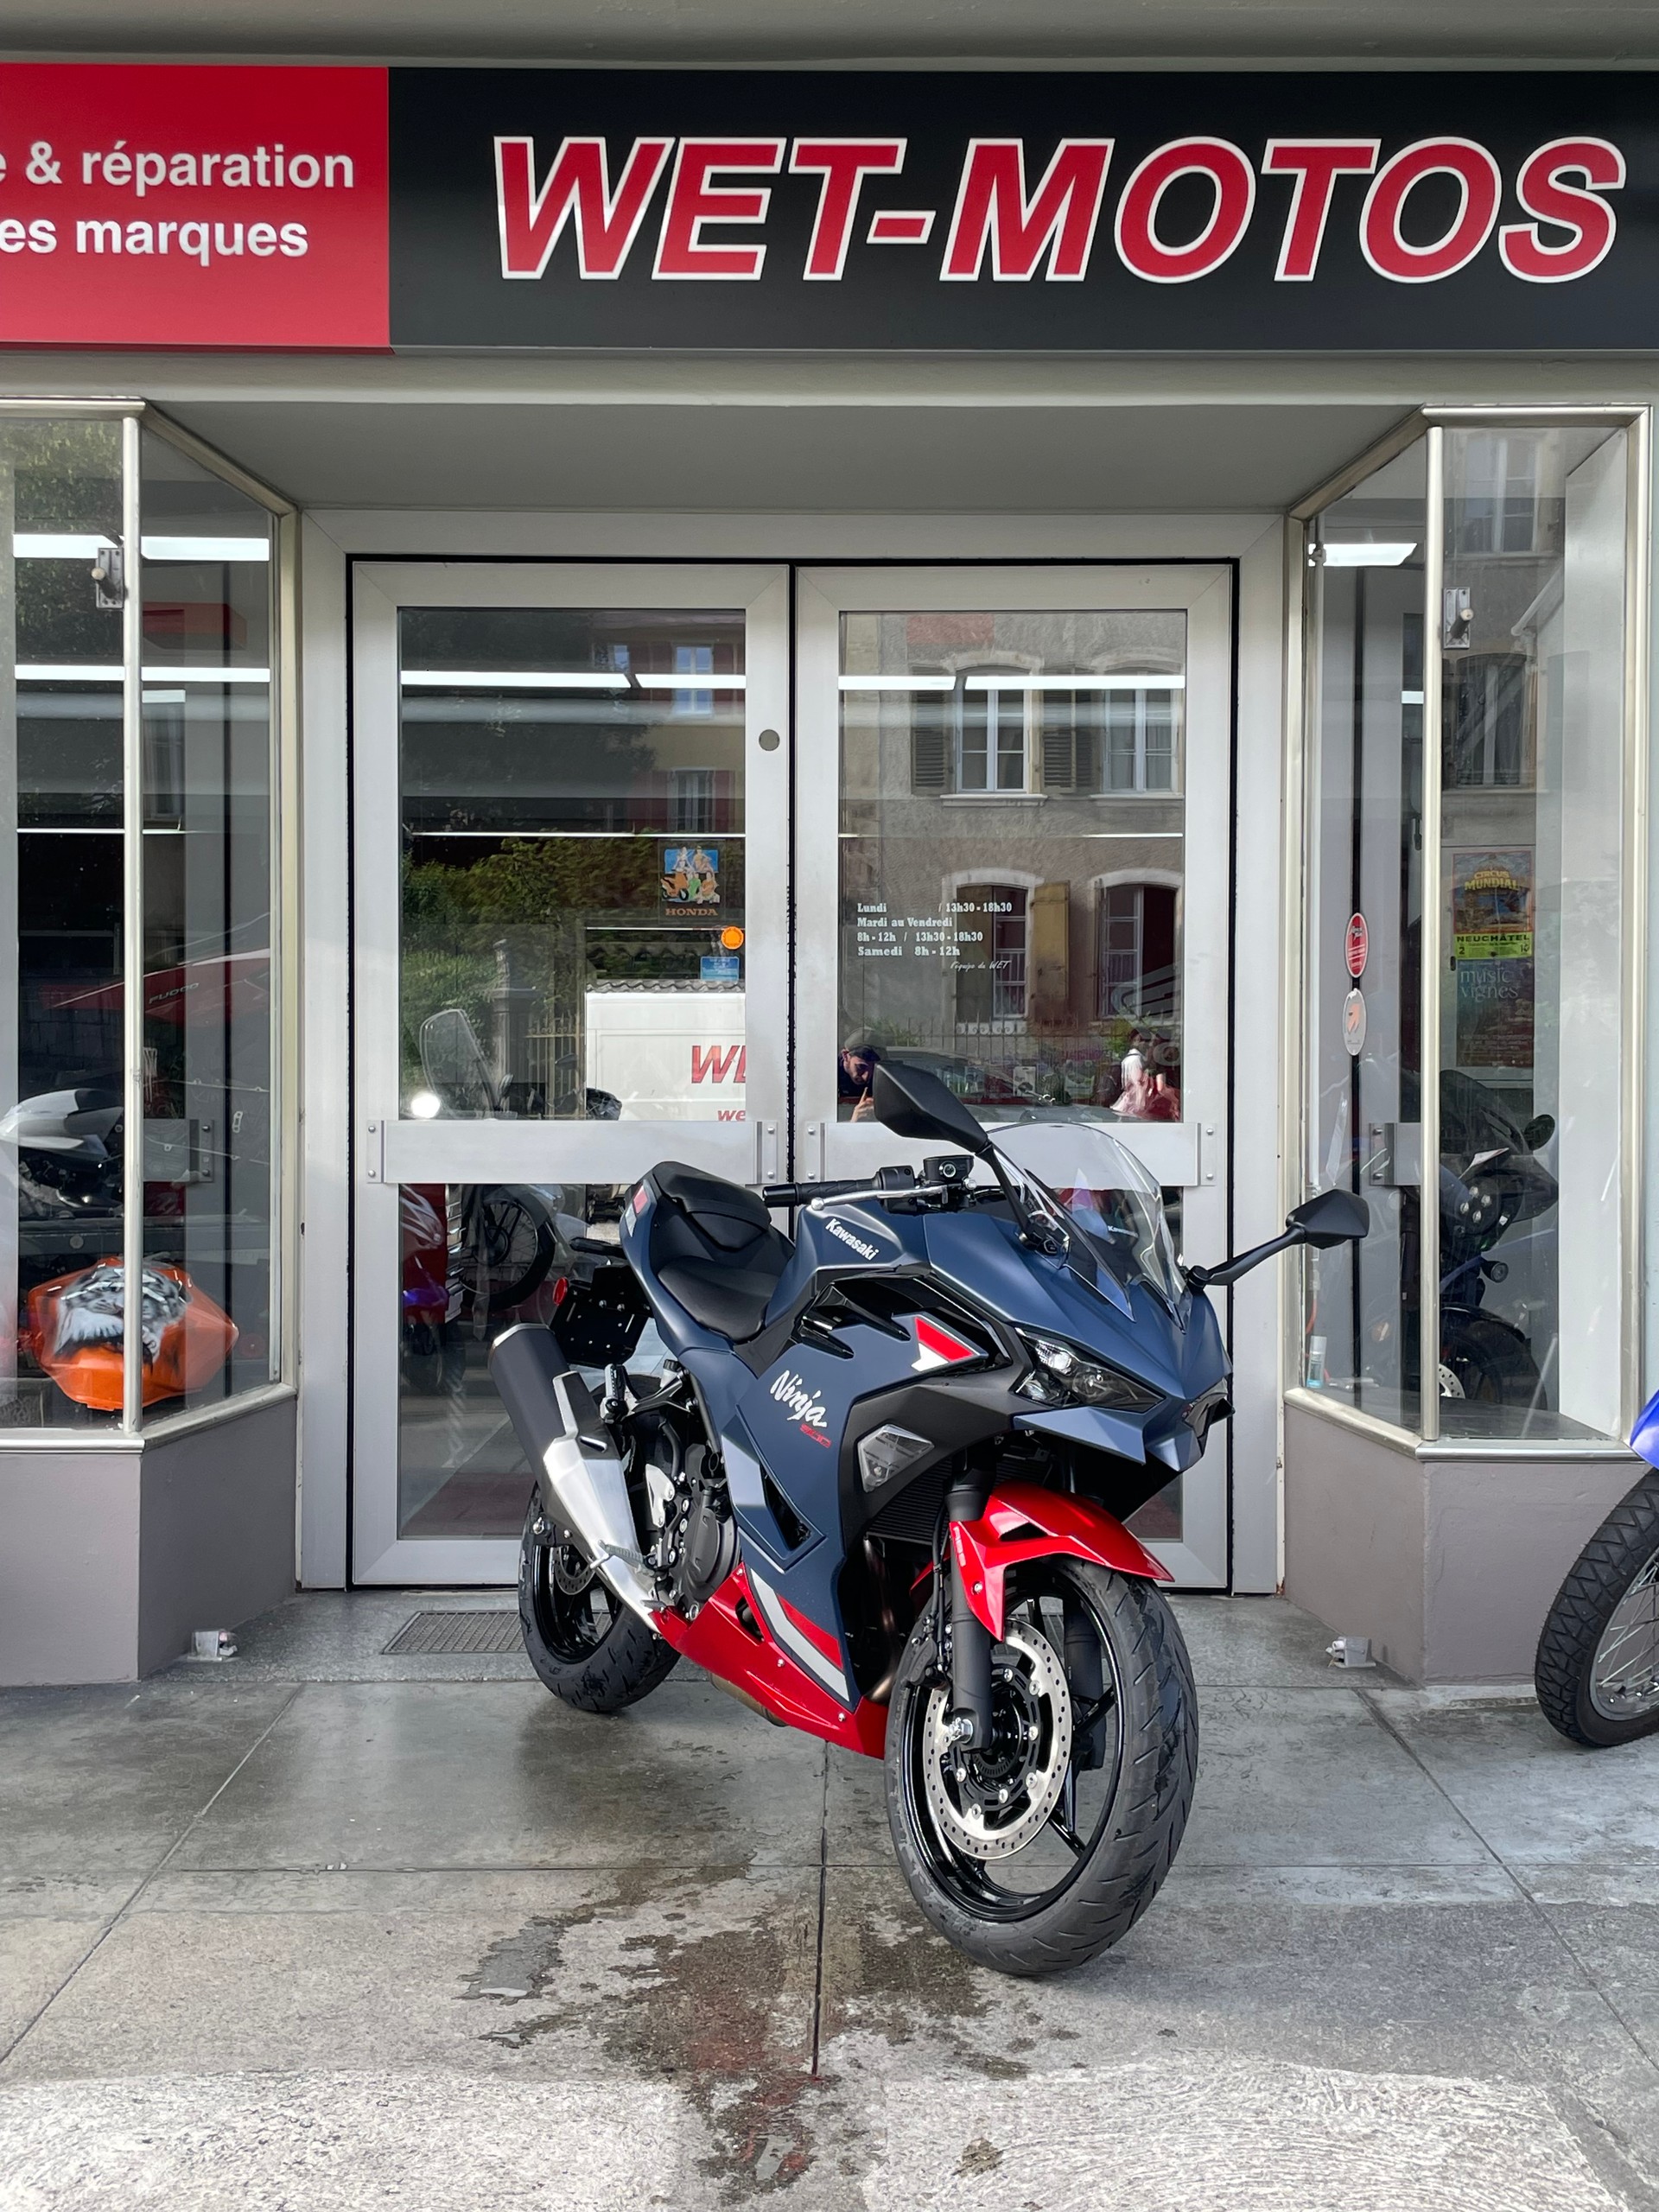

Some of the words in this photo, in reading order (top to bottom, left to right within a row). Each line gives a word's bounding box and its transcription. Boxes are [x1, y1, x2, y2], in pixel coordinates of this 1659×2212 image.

[25, 140, 63, 185] &
[81, 140, 355, 198] réparation
[493, 136, 1626, 284] WET-MOTOS
[75, 219, 309, 268] marques
[1473, 869, 1510, 880] CIRCUS
[1465, 876, 1520, 891] MUNDIAL
[664, 908, 719, 917] HONDA
[857, 903, 887, 912] Lundi
[945, 902, 975, 912] 13h30
[982, 902, 1013, 912] 18h30
[857, 918, 887, 927] Mardi
[907, 917, 953, 927] Vendredi
[857, 931, 870, 942] 8h
[878, 931, 896, 942] 12h
[915, 931, 945, 942] 13h30
[953, 931, 983, 942] 18h30
[1456, 933, 1530, 943] NEUCHÂTEL
[857, 946, 903, 957] Samedi
[914, 946, 930, 957] 8h
[939, 946, 961, 957] 12h
[1459, 946, 1465, 955] 2
[988, 960, 1013, 969] WET
[1460, 983, 1519, 1002] vignes
[825, 1217, 880, 1261] Kawasaki
[770, 1370, 828, 1427] Ninja
